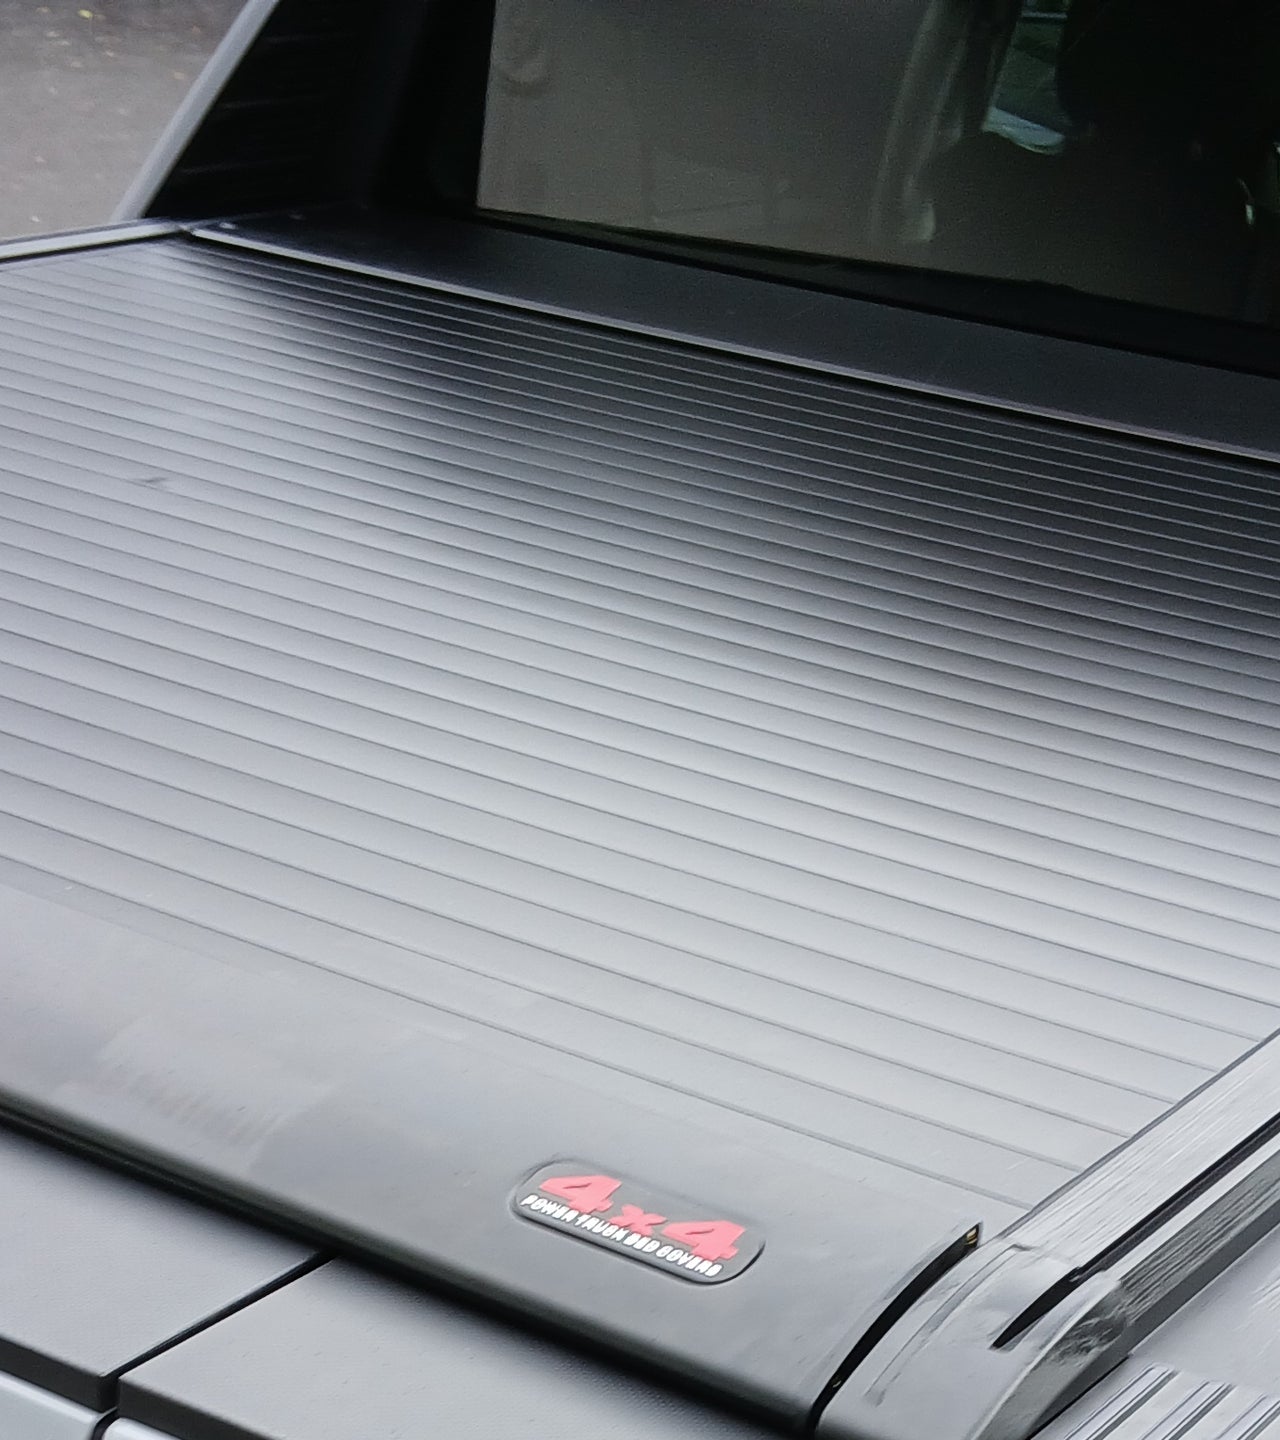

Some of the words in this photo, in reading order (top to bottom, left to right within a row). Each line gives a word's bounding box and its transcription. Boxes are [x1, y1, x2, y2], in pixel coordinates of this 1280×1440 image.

[520, 1194, 580, 1223] POWER
[574, 1213, 630, 1242] TRUCK
[622, 1231, 661, 1254] BED
[655, 1245, 724, 1277] COVERS
